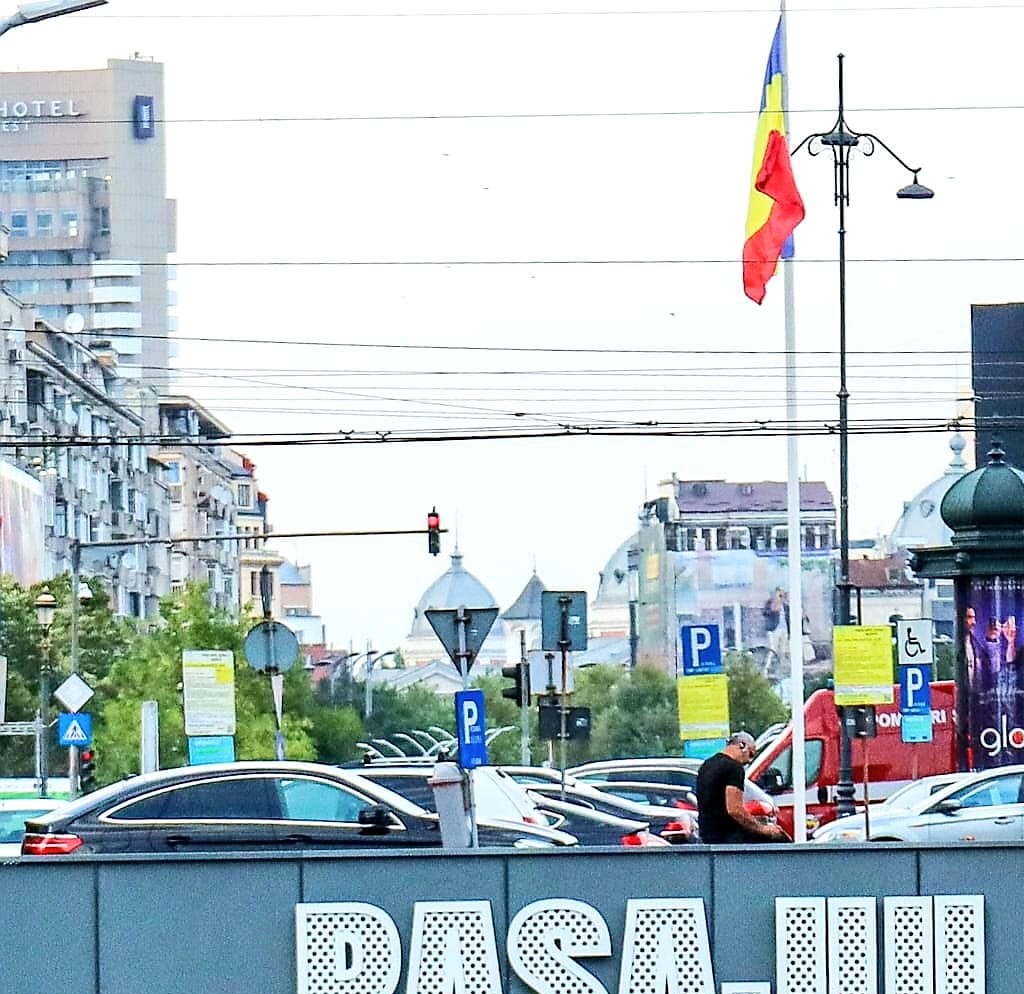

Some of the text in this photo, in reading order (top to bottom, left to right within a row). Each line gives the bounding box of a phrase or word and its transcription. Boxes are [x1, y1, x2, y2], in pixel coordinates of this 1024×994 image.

[690, 627, 712, 668] P
[906, 668, 923, 707] P
[462, 700, 479, 744] P
